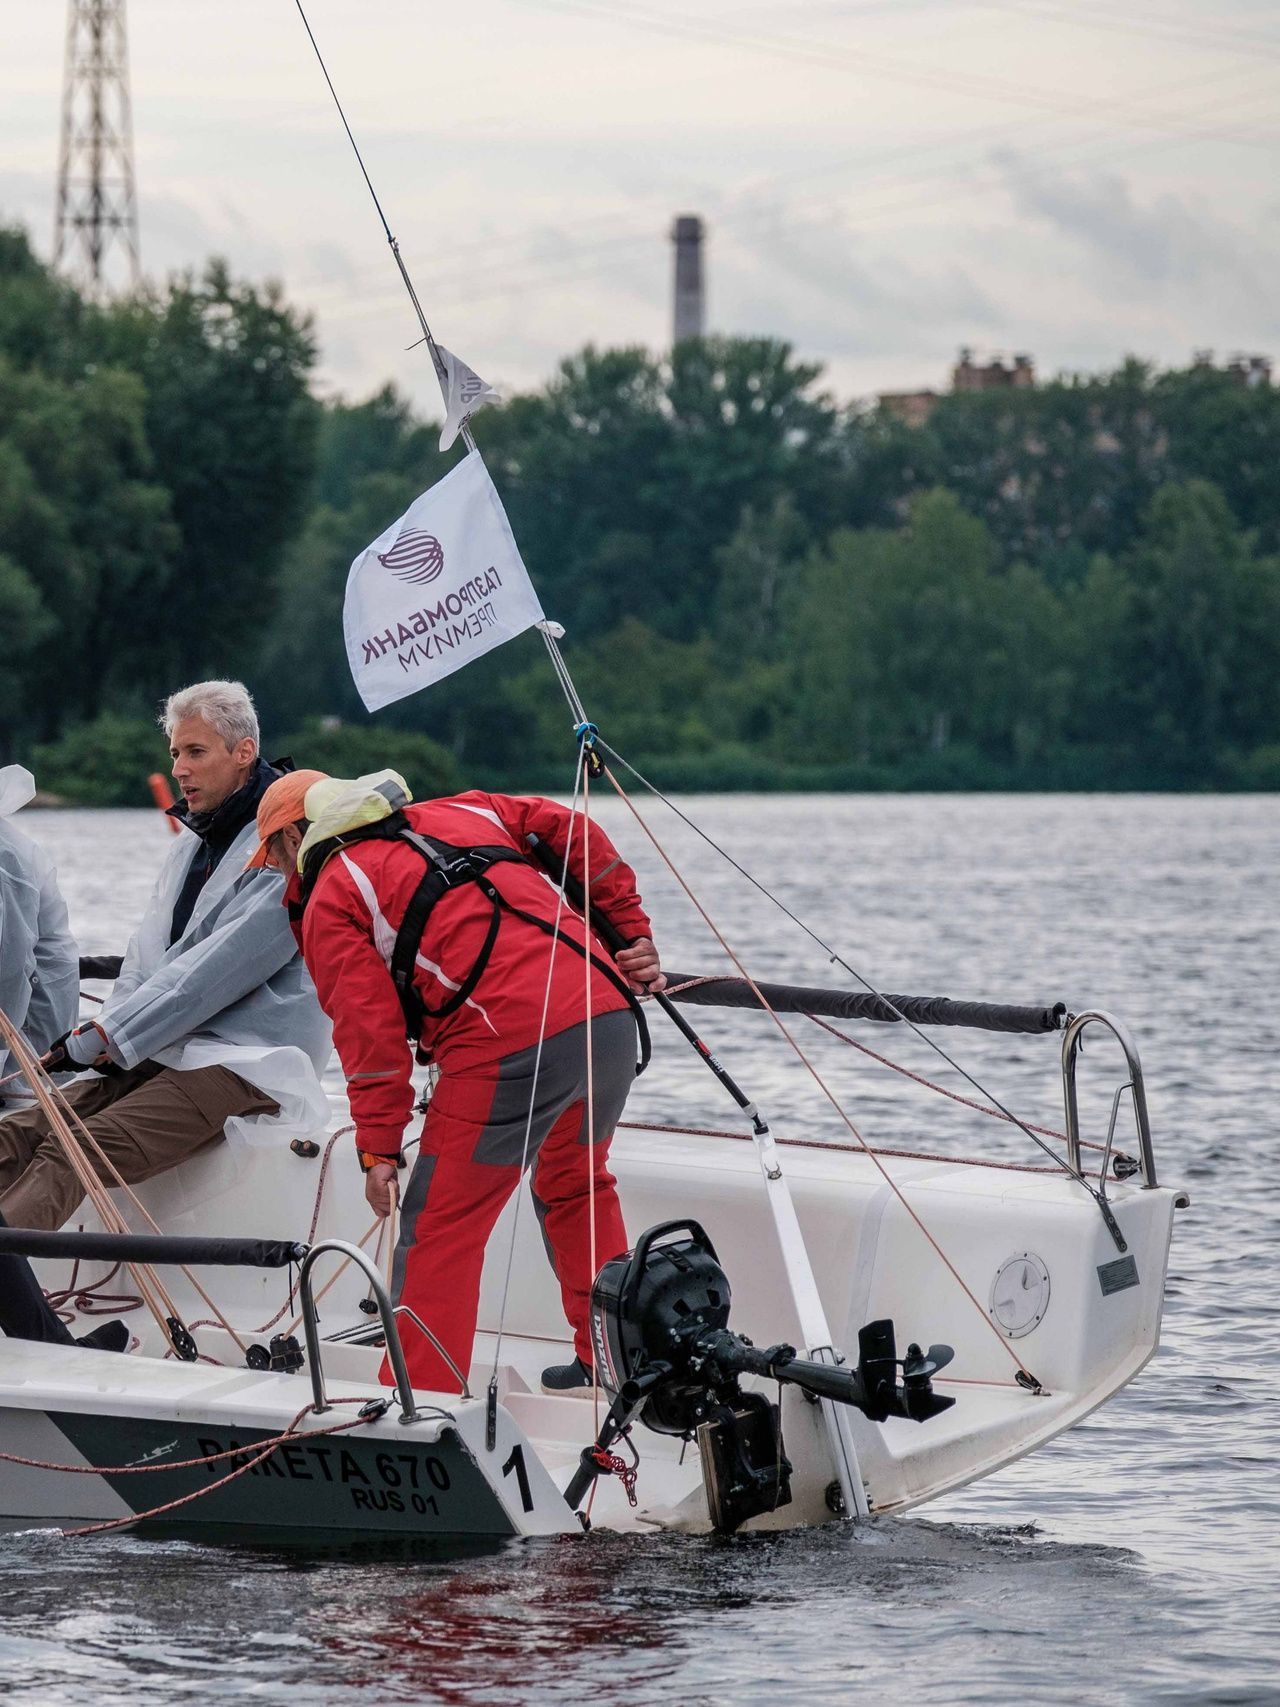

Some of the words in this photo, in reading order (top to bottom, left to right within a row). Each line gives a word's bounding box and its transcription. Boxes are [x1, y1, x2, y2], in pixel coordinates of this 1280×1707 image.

[594, 1314, 614, 1386] SUZUKI
[375, 1452, 451, 1491] 670
[501, 1443, 535, 1514] 1
[350, 1488, 406, 1513] RUS
[412, 1495, 440, 1516] 01
